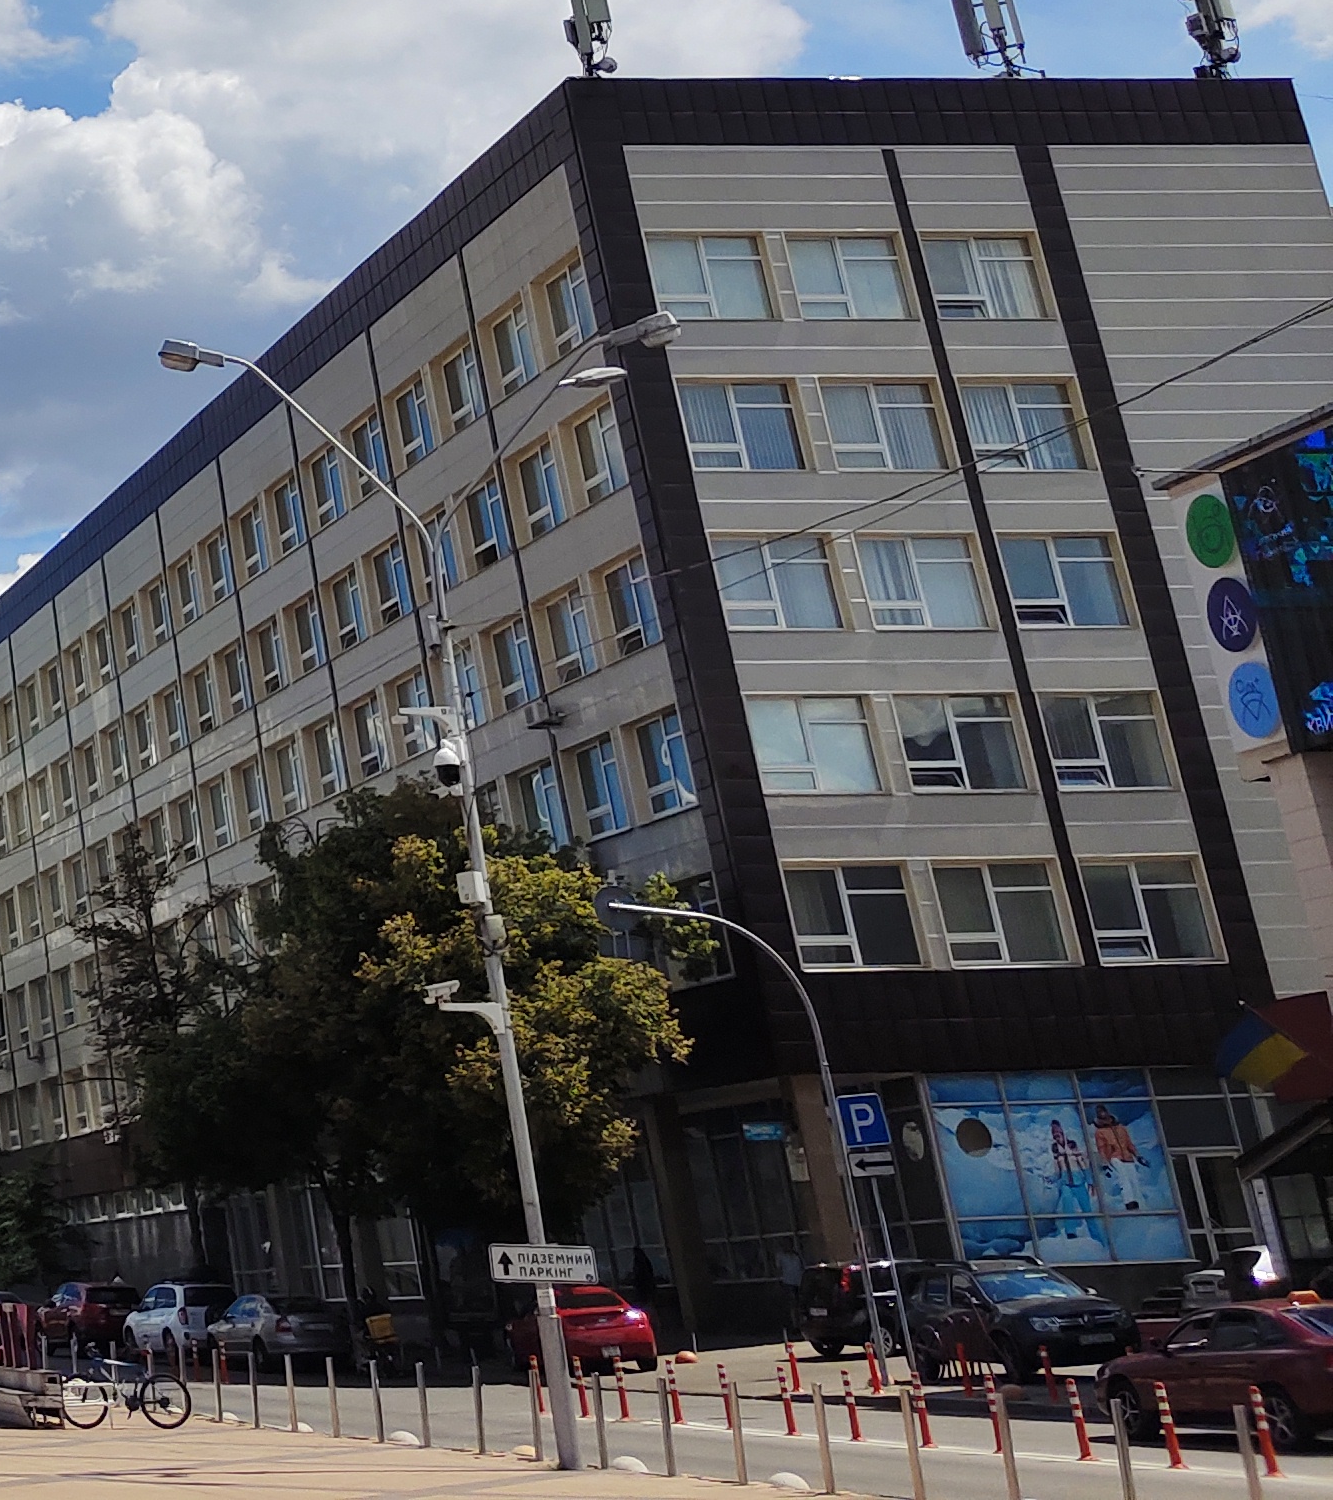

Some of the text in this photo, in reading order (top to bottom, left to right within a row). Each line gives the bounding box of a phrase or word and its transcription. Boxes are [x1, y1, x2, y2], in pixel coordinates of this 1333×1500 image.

[849, 1103, 875, 1142] P
[517, 1252, 592, 1265] ПІДЗЕМНИЙ
[519, 1266, 573, 1278] ПАРКІНГ
